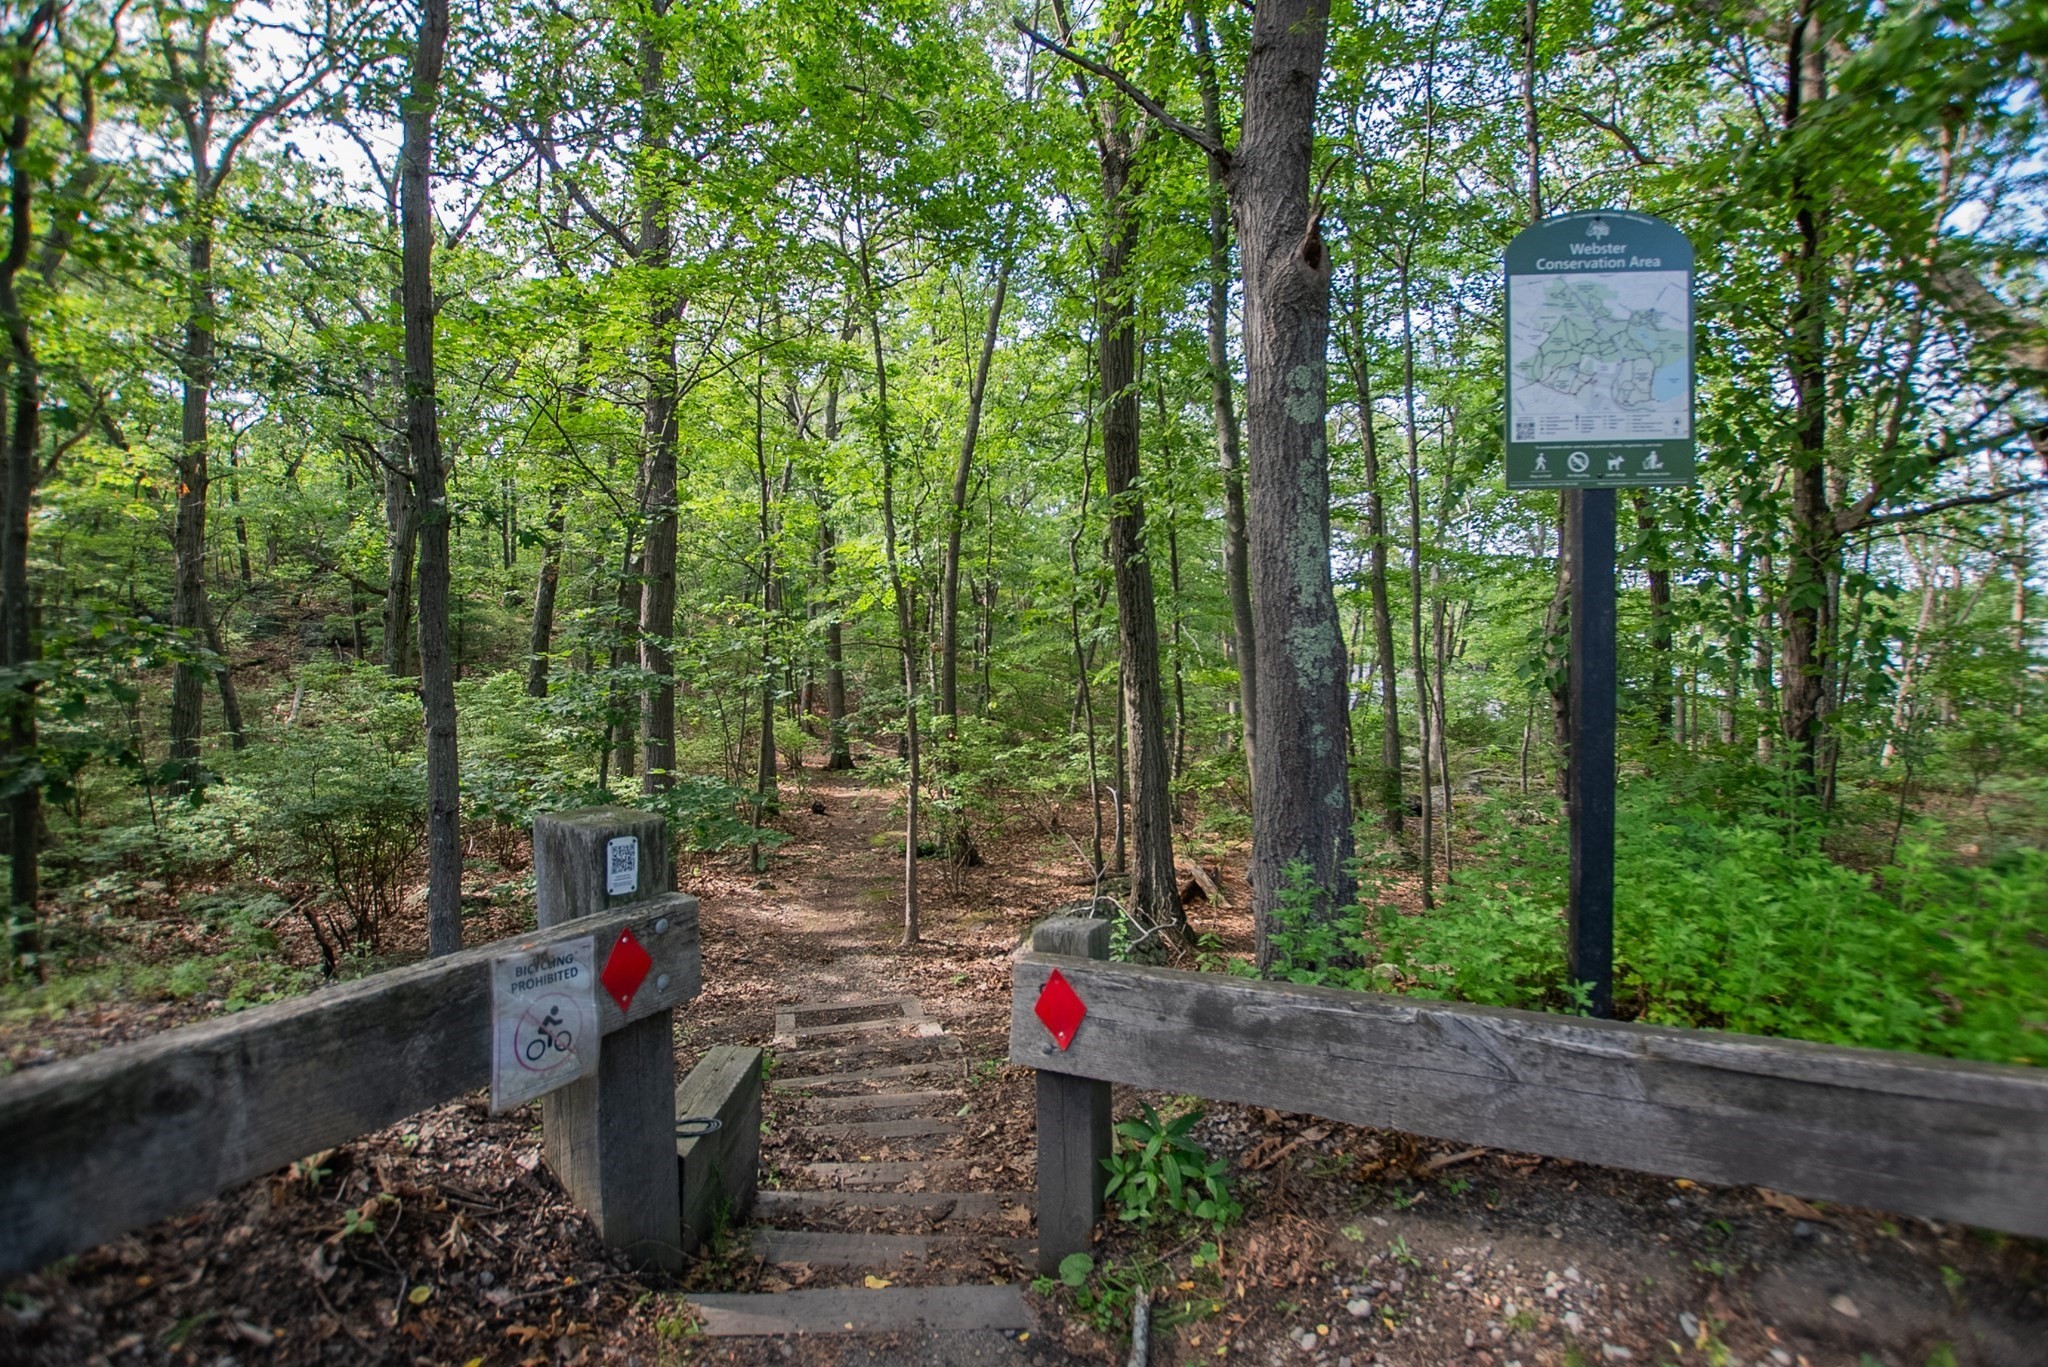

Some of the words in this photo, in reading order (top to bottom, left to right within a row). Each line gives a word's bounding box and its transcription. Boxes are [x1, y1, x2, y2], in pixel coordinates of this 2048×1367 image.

[1569, 242, 1627, 255] Webster
[1536, 256, 1626, 270] Conservation
[1629, 256, 1661, 268] Area
[515, 953, 574, 977] BICYCLING
[511, 966, 578, 994] PROHIBITED
